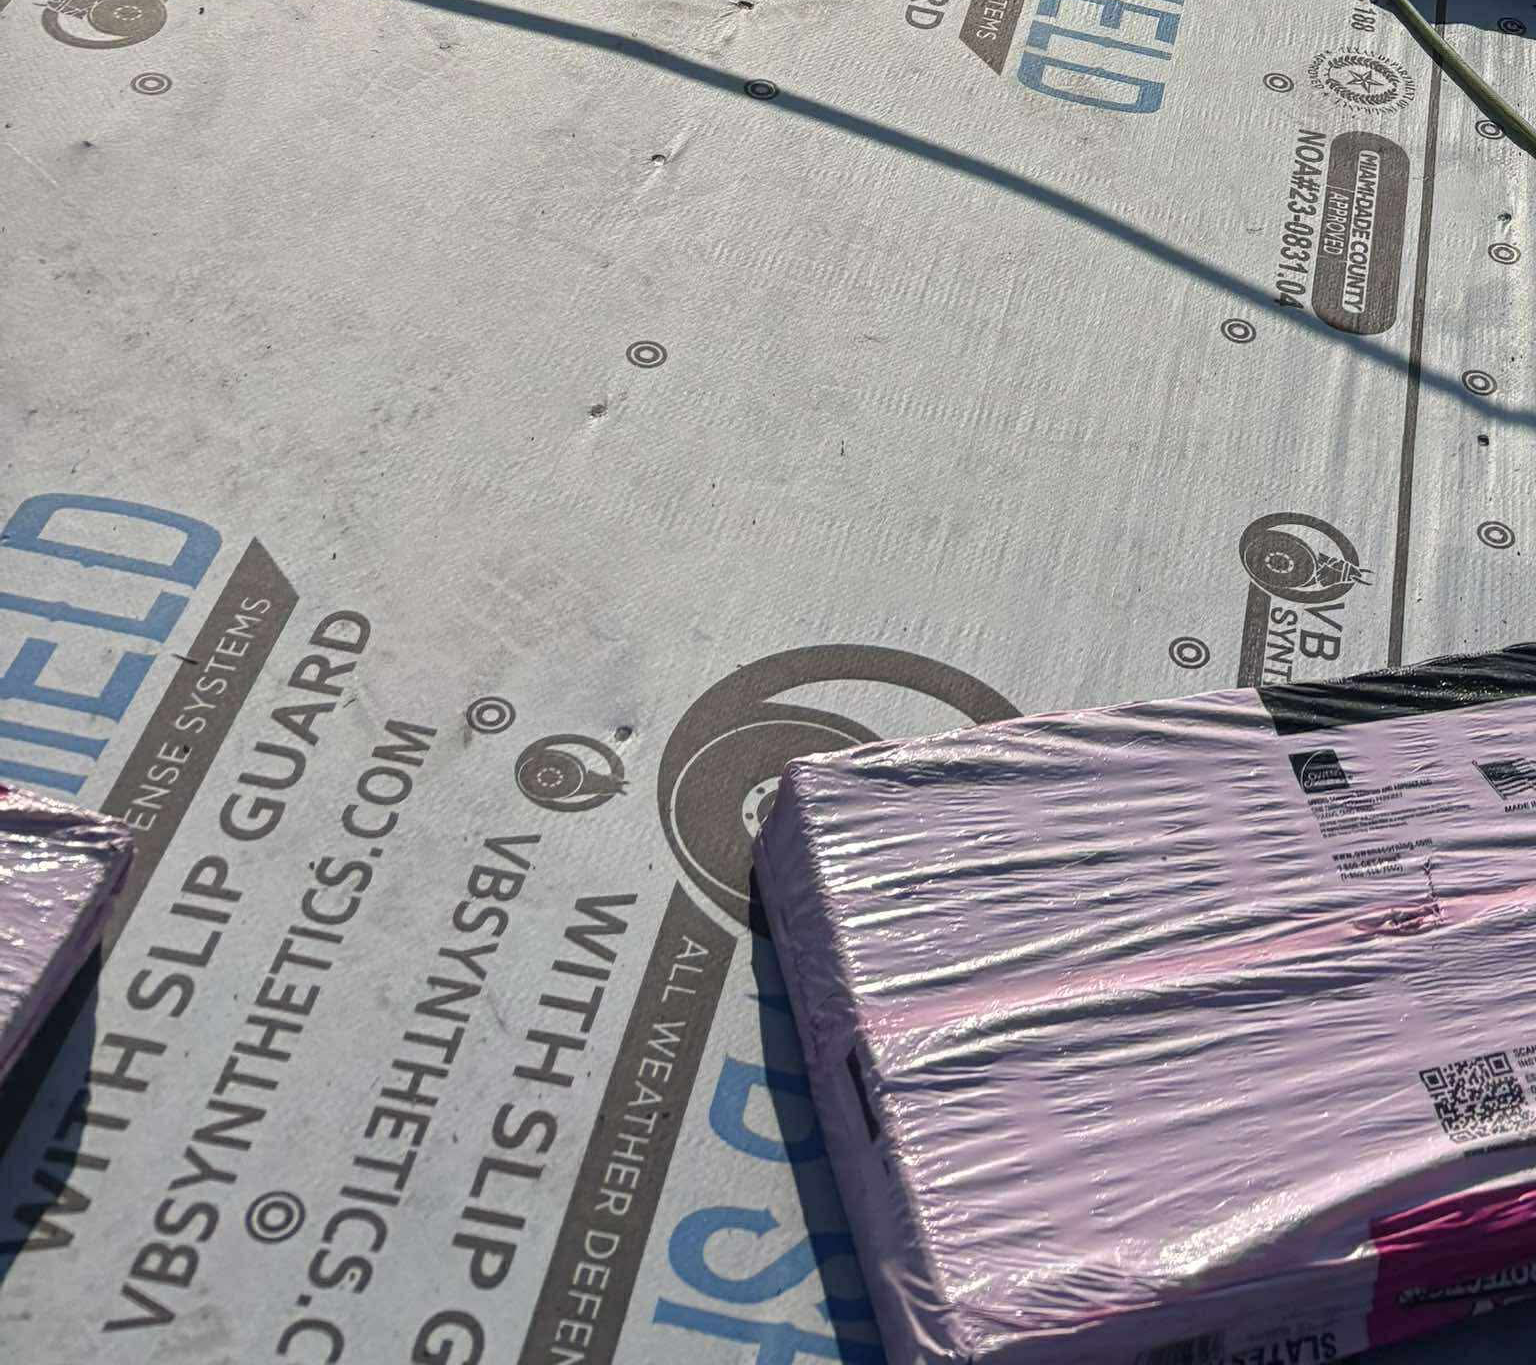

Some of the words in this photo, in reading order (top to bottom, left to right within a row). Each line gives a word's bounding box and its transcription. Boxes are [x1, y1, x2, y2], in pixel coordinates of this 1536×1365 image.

[1351, 7, 1378, 32] 188
[1273, 129, 1327, 309] NOA#23-0831.04
[1323, 191, 1349, 256] APPROVED
[1343, 239, 1370, 312] COUNTY
[0, 492, 222, 796] IELD
[126, 742, 193, 831] ENSE
[177, 597, 271, 734] SYSTEMS
[1263, 607, 1298, 685] SYNT
[1300, 602, 1345, 661] VB
[1503, 800, 1529, 814] MADE
[2, 1032, 167, 1254] WITH
[126, 854, 242, 1018] SLIP
[219, 609, 372, 841] GUARD
[513, 893, 638, 1088] WITH
[661, 935, 705, 1004] ALL
[101, 719, 438, 1333] VBSYNTHETICS.COM
[452, 1103, 559, 1290] SLIP
[594, 1021, 686, 1216] WEATHER
